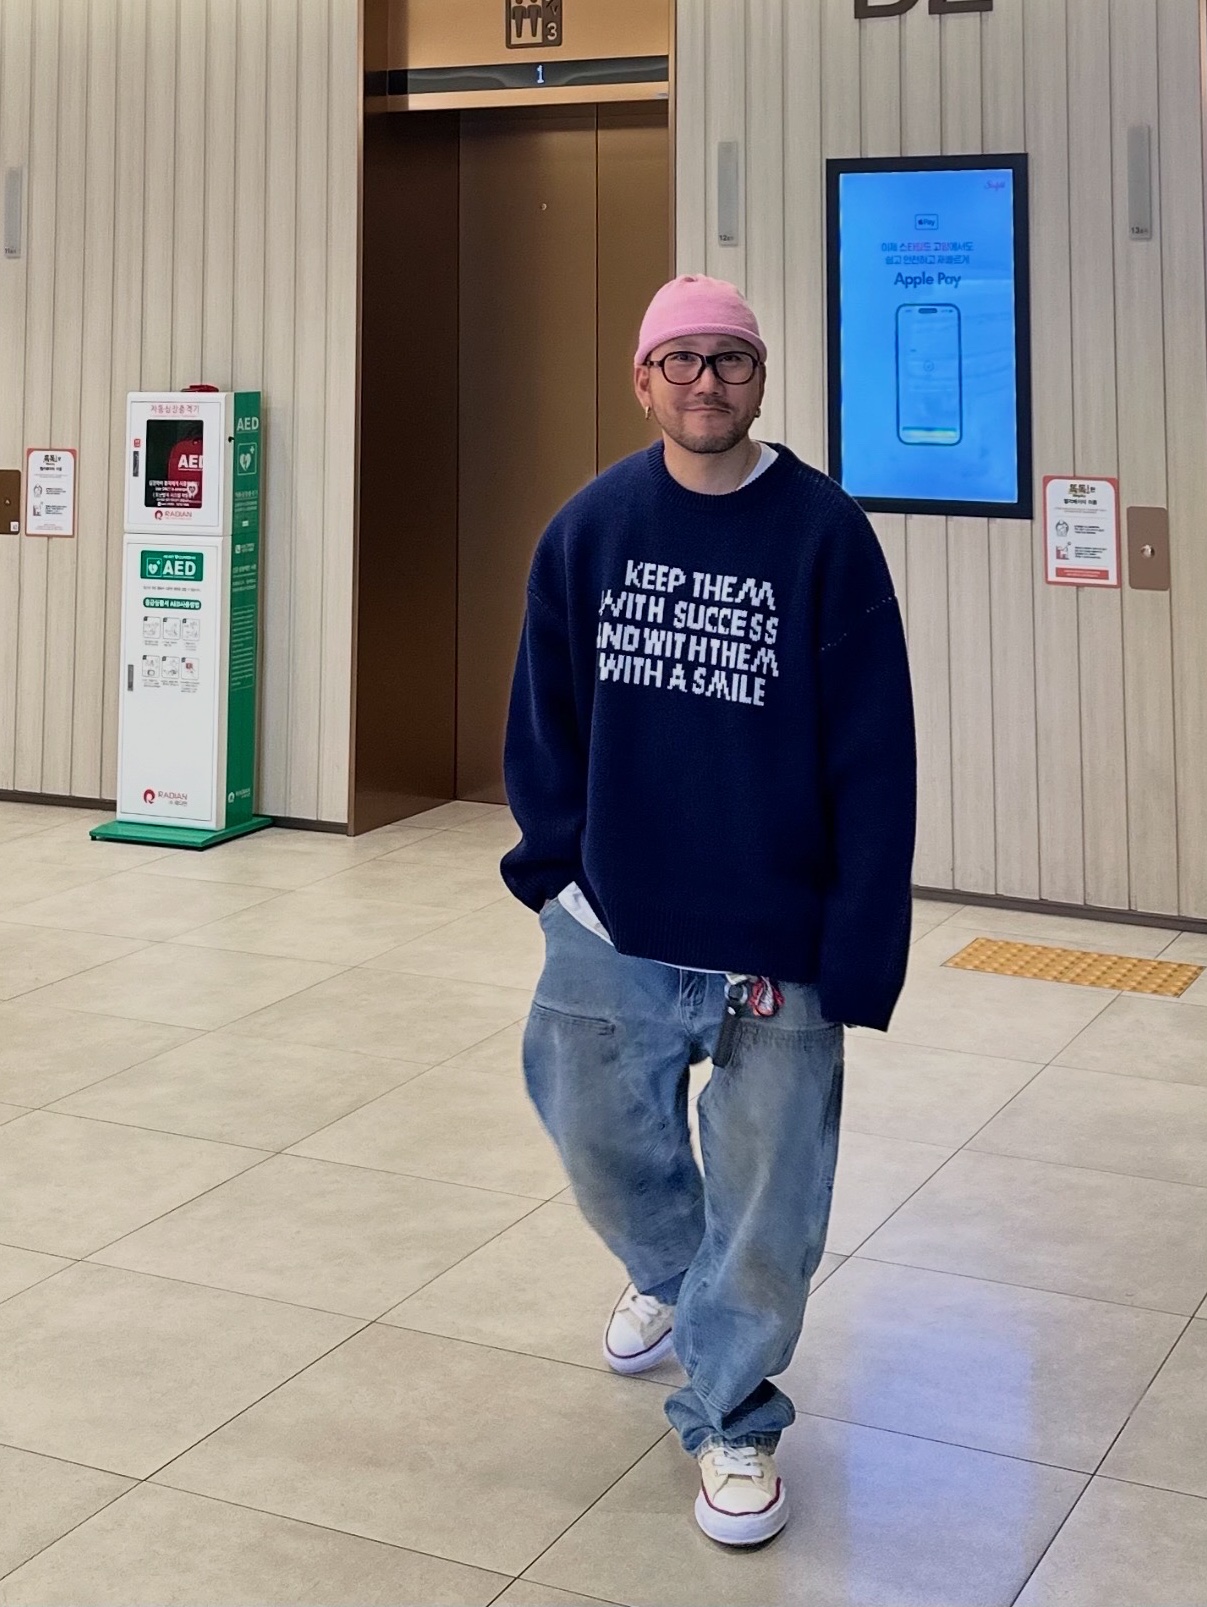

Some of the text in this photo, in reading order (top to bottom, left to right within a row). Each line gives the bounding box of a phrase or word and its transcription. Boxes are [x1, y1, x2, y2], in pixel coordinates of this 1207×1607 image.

[547, 22, 557, 40] 3
[537, 65, 545, 84] 1
[893, 271, 962, 289] Apple Pay
[236, 416, 259, 431] AED
[162, 560, 196, 576] AED
[625, 559, 776, 610] KEEP THEM
[673, 600, 779, 645] SUCCESS
[643, 627, 708, 664] WITH
[710, 638, 779, 678] THEM
[599, 652, 766, 707] WITH A SMILE
